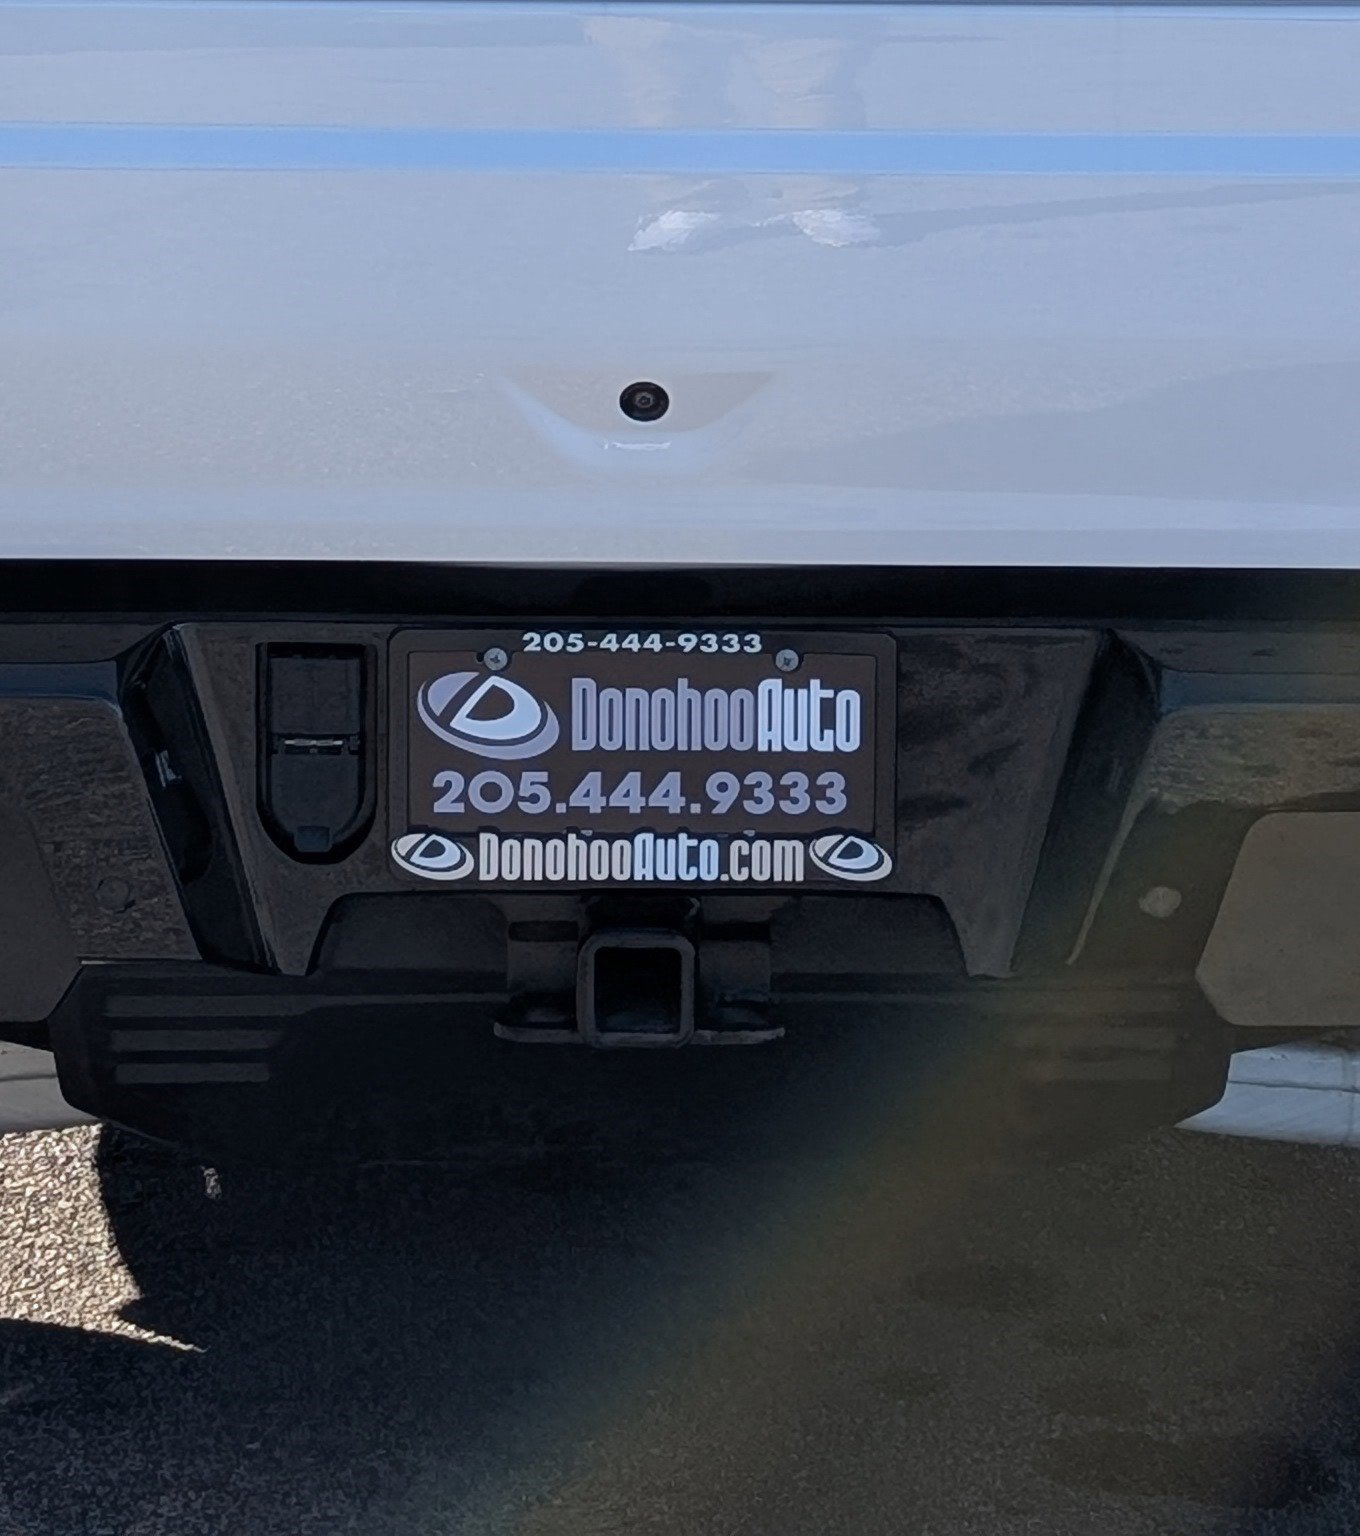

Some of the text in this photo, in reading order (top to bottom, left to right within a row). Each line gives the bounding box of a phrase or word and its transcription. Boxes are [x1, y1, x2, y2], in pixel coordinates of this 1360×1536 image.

[522, 632, 763, 653] 205-444-9333
[570, 677, 862, 752] DonohooAuto
[432, 769, 848, 815] 205.444.9333
[478, 832, 805, 882] DonohooAuto.com
